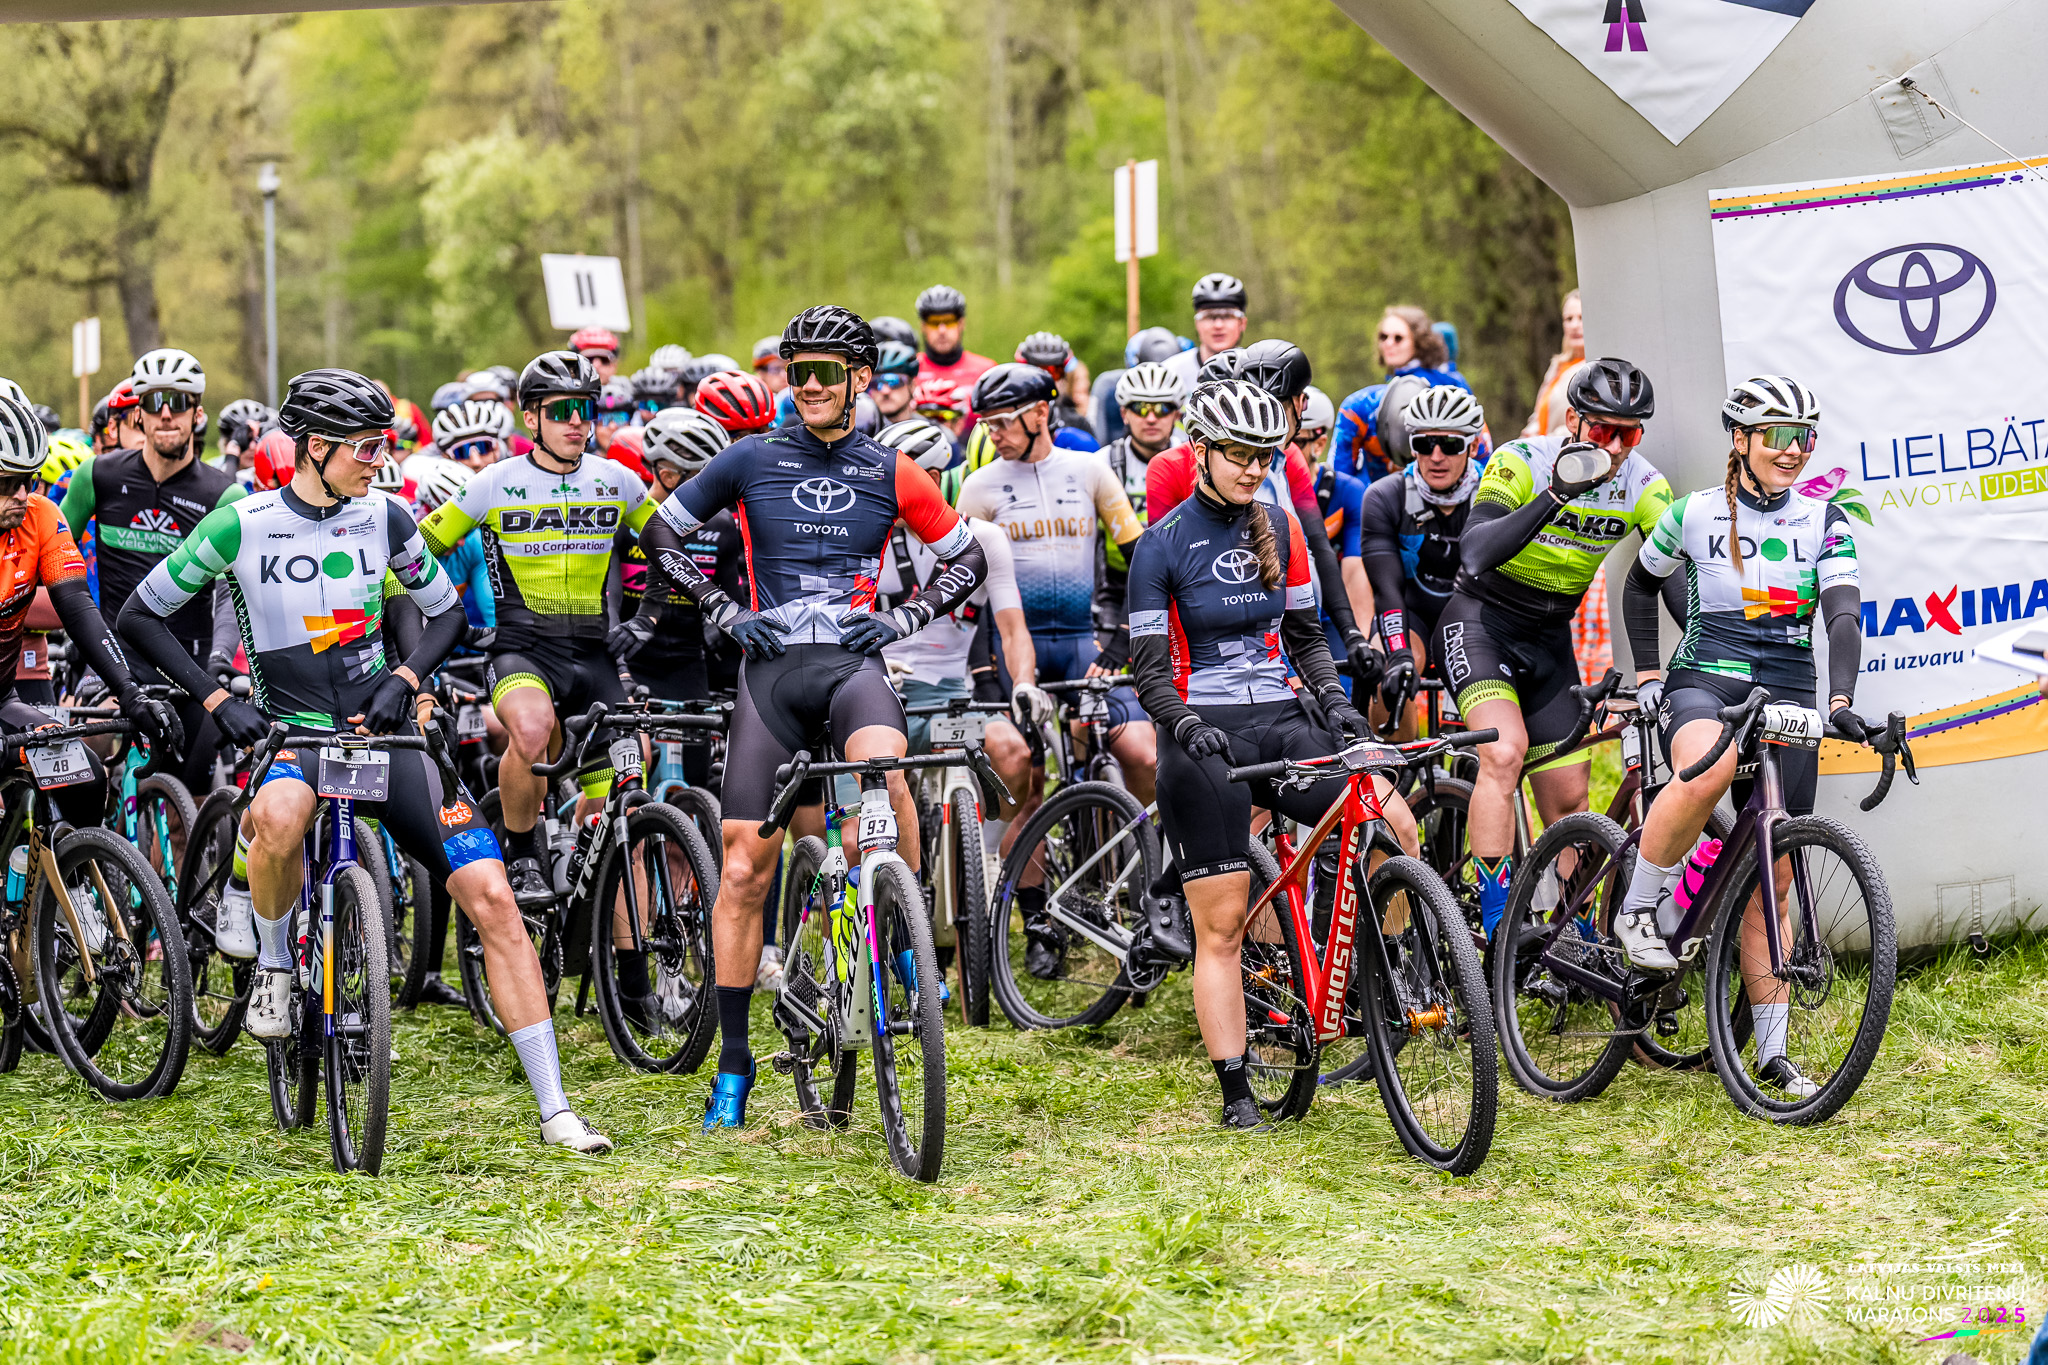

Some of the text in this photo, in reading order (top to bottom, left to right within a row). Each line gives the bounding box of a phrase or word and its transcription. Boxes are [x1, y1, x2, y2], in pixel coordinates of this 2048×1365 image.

[1880, 480, 1977, 511] AVOTA
[500, 505, 620, 534] DAKO
[1551, 512, 1628, 537] AKO
[793, 522, 849, 537] TOYOTA
[524, 540, 605, 555] D8 Corporation
[1548, 535, 1606, 553] Corporation
[260, 548, 376, 584] KOOL
[1222, 592, 1268, 606] TOYOTA
[1894, 650, 1964, 674] uzvaru
[1782, 719, 1807, 734] 104
[950, 730, 965, 740] 51
[1778, 735, 1803, 745] TOYOTA
[1364, 750, 1384, 760] 20
[52, 760, 69, 773] 48
[54, 775, 78, 783] TOYOTA
[349, 770, 358, 785] 1
[338, 787, 367, 796] TOYOTA
[867, 820, 887, 836] 93
[574, 795, 616, 900] TREK
[18, 832, 41, 952] PINARELLO
